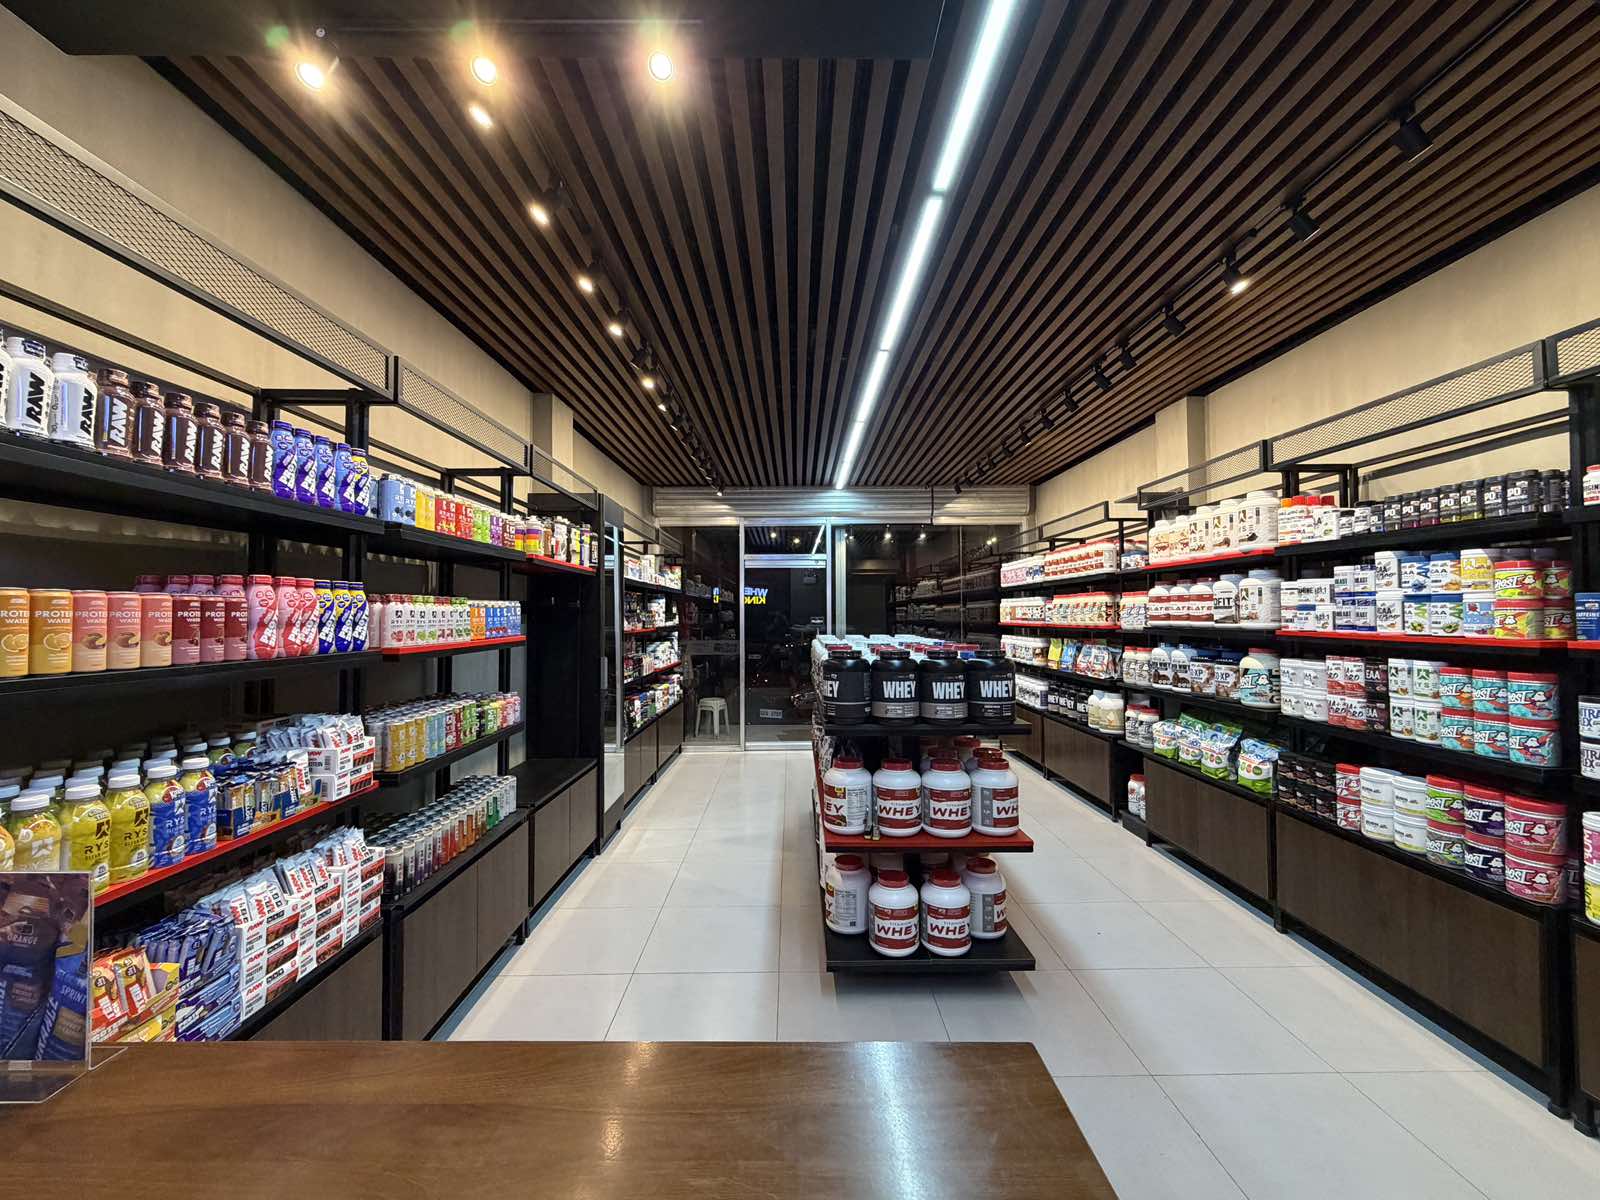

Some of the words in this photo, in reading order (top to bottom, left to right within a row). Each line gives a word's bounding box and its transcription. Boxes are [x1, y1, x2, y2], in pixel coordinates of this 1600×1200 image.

[26, 371, 45, 424] RAW
[80, 387, 95, 436] RAW
[110, 397, 127, 447] RAW
[151, 410, 165, 456] RAW
[184, 421, 198, 463] RAW
[211, 429, 225, 470] RAW
[239, 438, 250, 476] RAW
[263, 445, 274, 481] RAW
[883, 680, 916, 699] WHEY
[932, 682, 965, 700] WHEY
[980, 680, 1013, 698] WHEY
[879, 804, 921, 817] WHEY
[84, 840, 109, 855] RYS
[124, 828, 147, 840] RYS
[60, 984, 88, 1005] SPRINT
